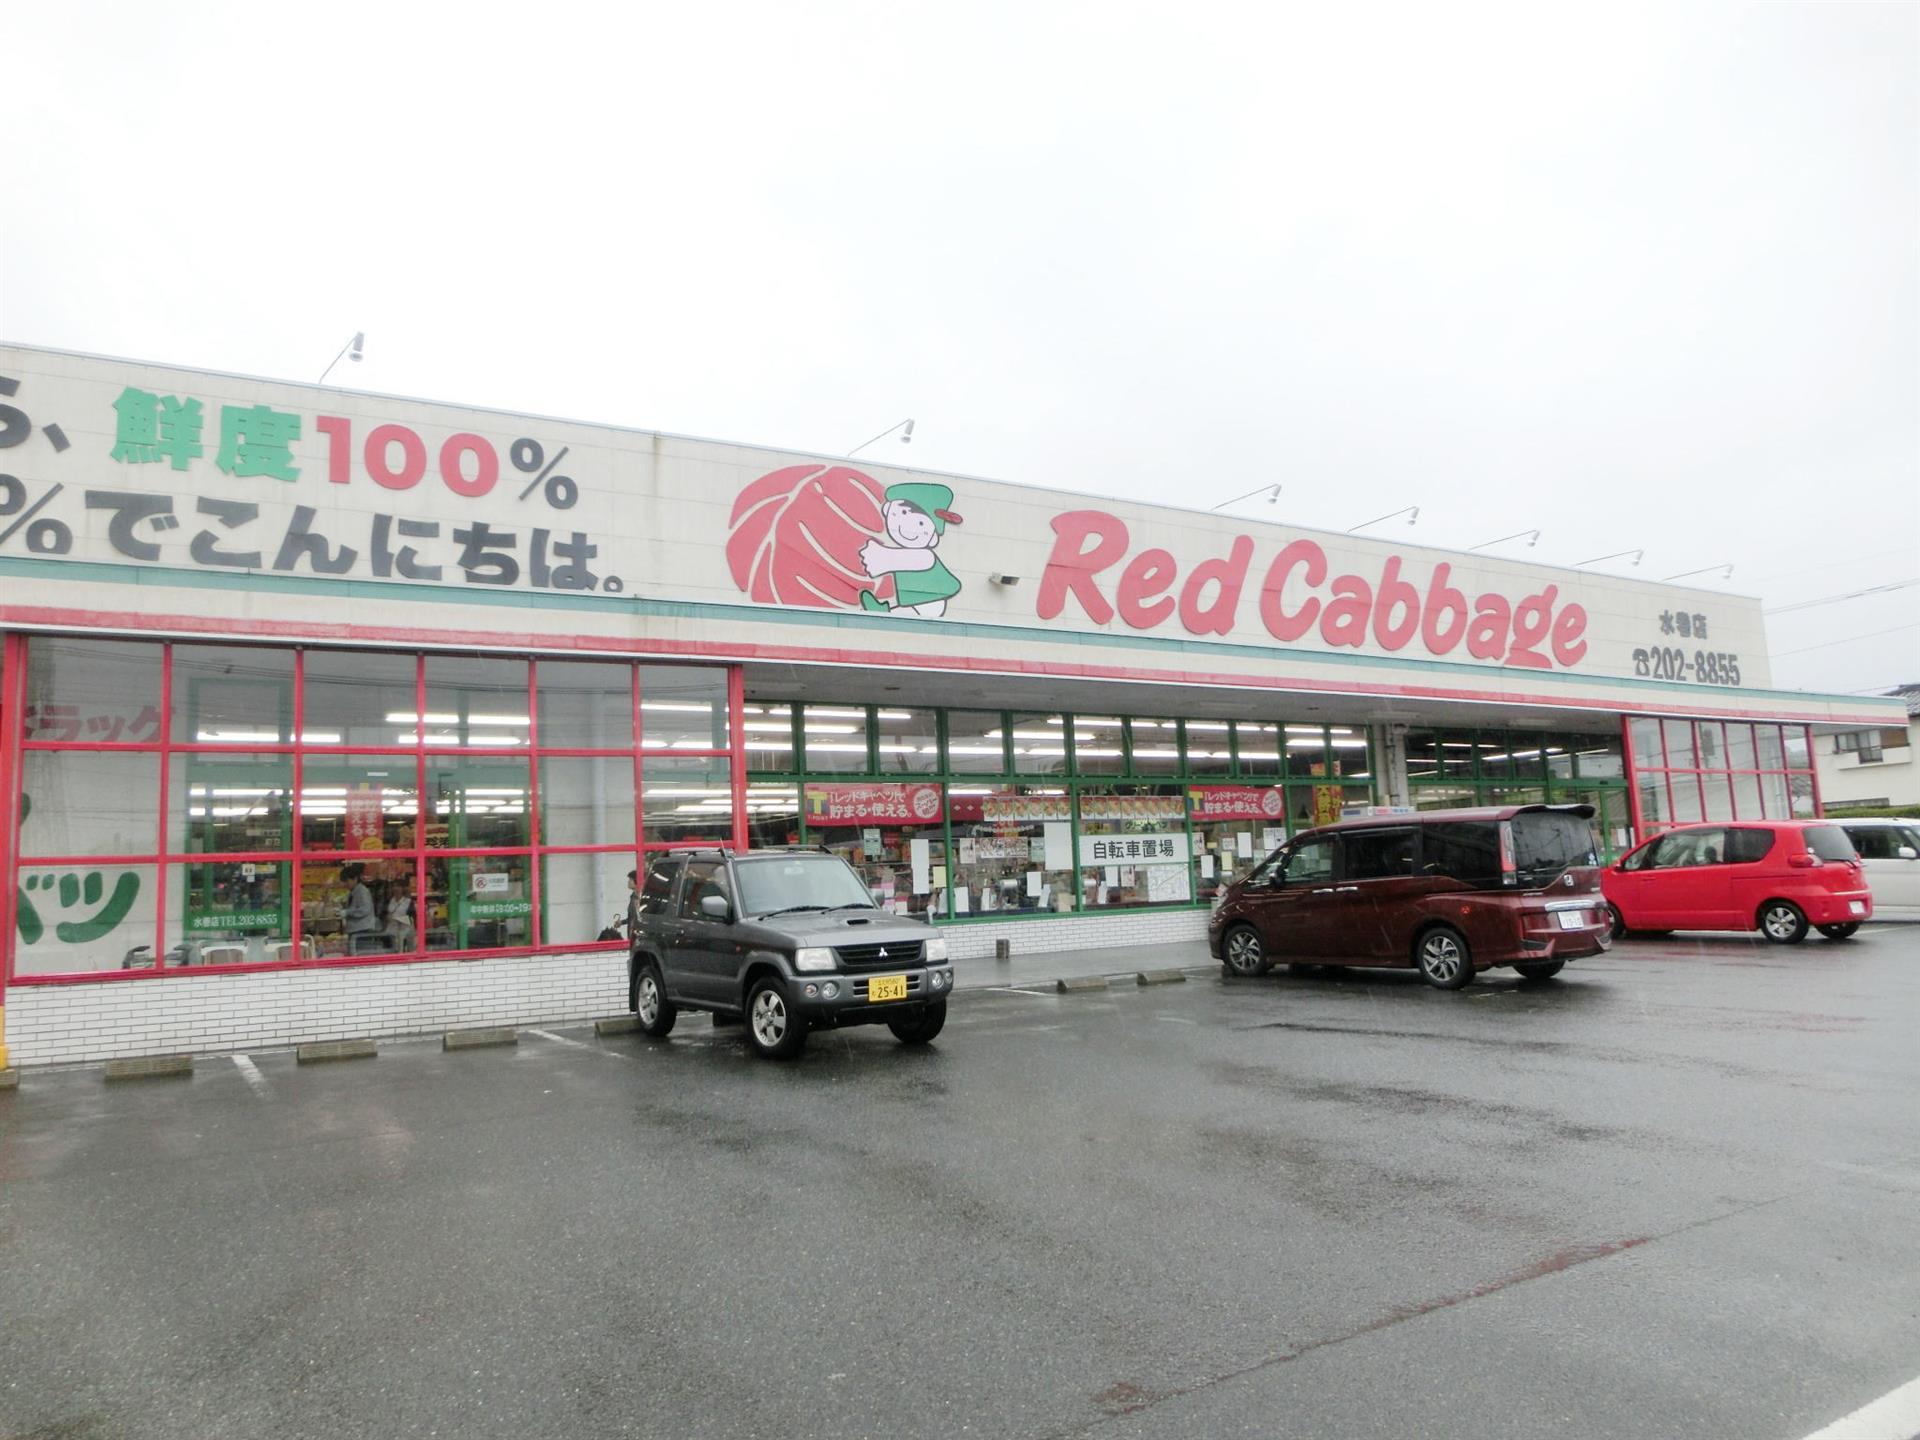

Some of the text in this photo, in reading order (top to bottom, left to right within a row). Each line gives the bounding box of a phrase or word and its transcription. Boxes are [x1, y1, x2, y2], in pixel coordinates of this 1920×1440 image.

[1037, 510, 1587, 669] Red Cabbage
[1093, 839, 1174, 860] 自転車置場
